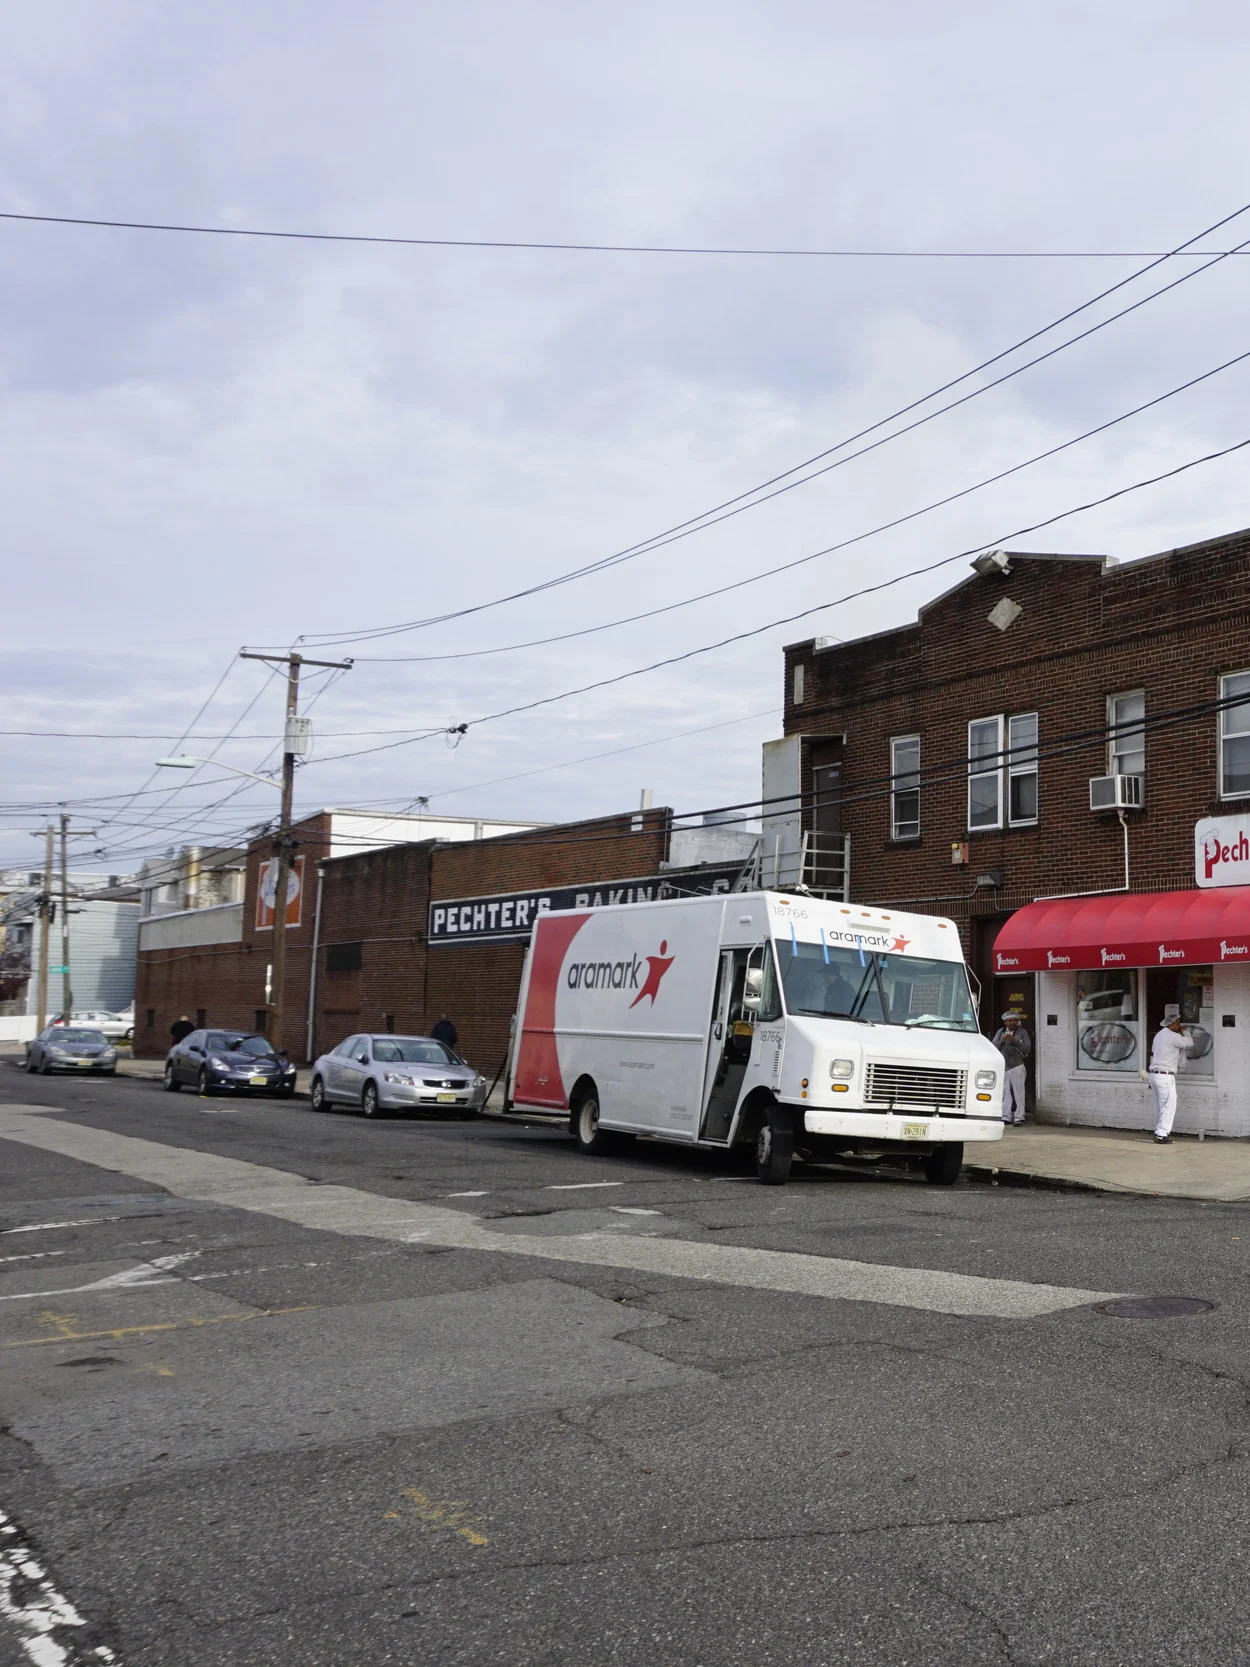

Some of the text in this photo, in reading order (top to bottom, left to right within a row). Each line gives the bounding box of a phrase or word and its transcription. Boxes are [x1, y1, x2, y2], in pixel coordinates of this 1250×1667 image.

[434, 898, 551, 933] PECHTER'S
[773, 905, 809, 919] 18766
[829, 930, 890, 947] aramark
[1047, 951, 1071, 968] Pechter's
[1101, 947, 1126, 966] Pechter's
[1158, 944, 1185, 963] Pechter's
[1220, 940, 1248, 960] Pechter's
[567, 952, 642, 989] aramark
[760, 1030, 782, 1043] 18766
